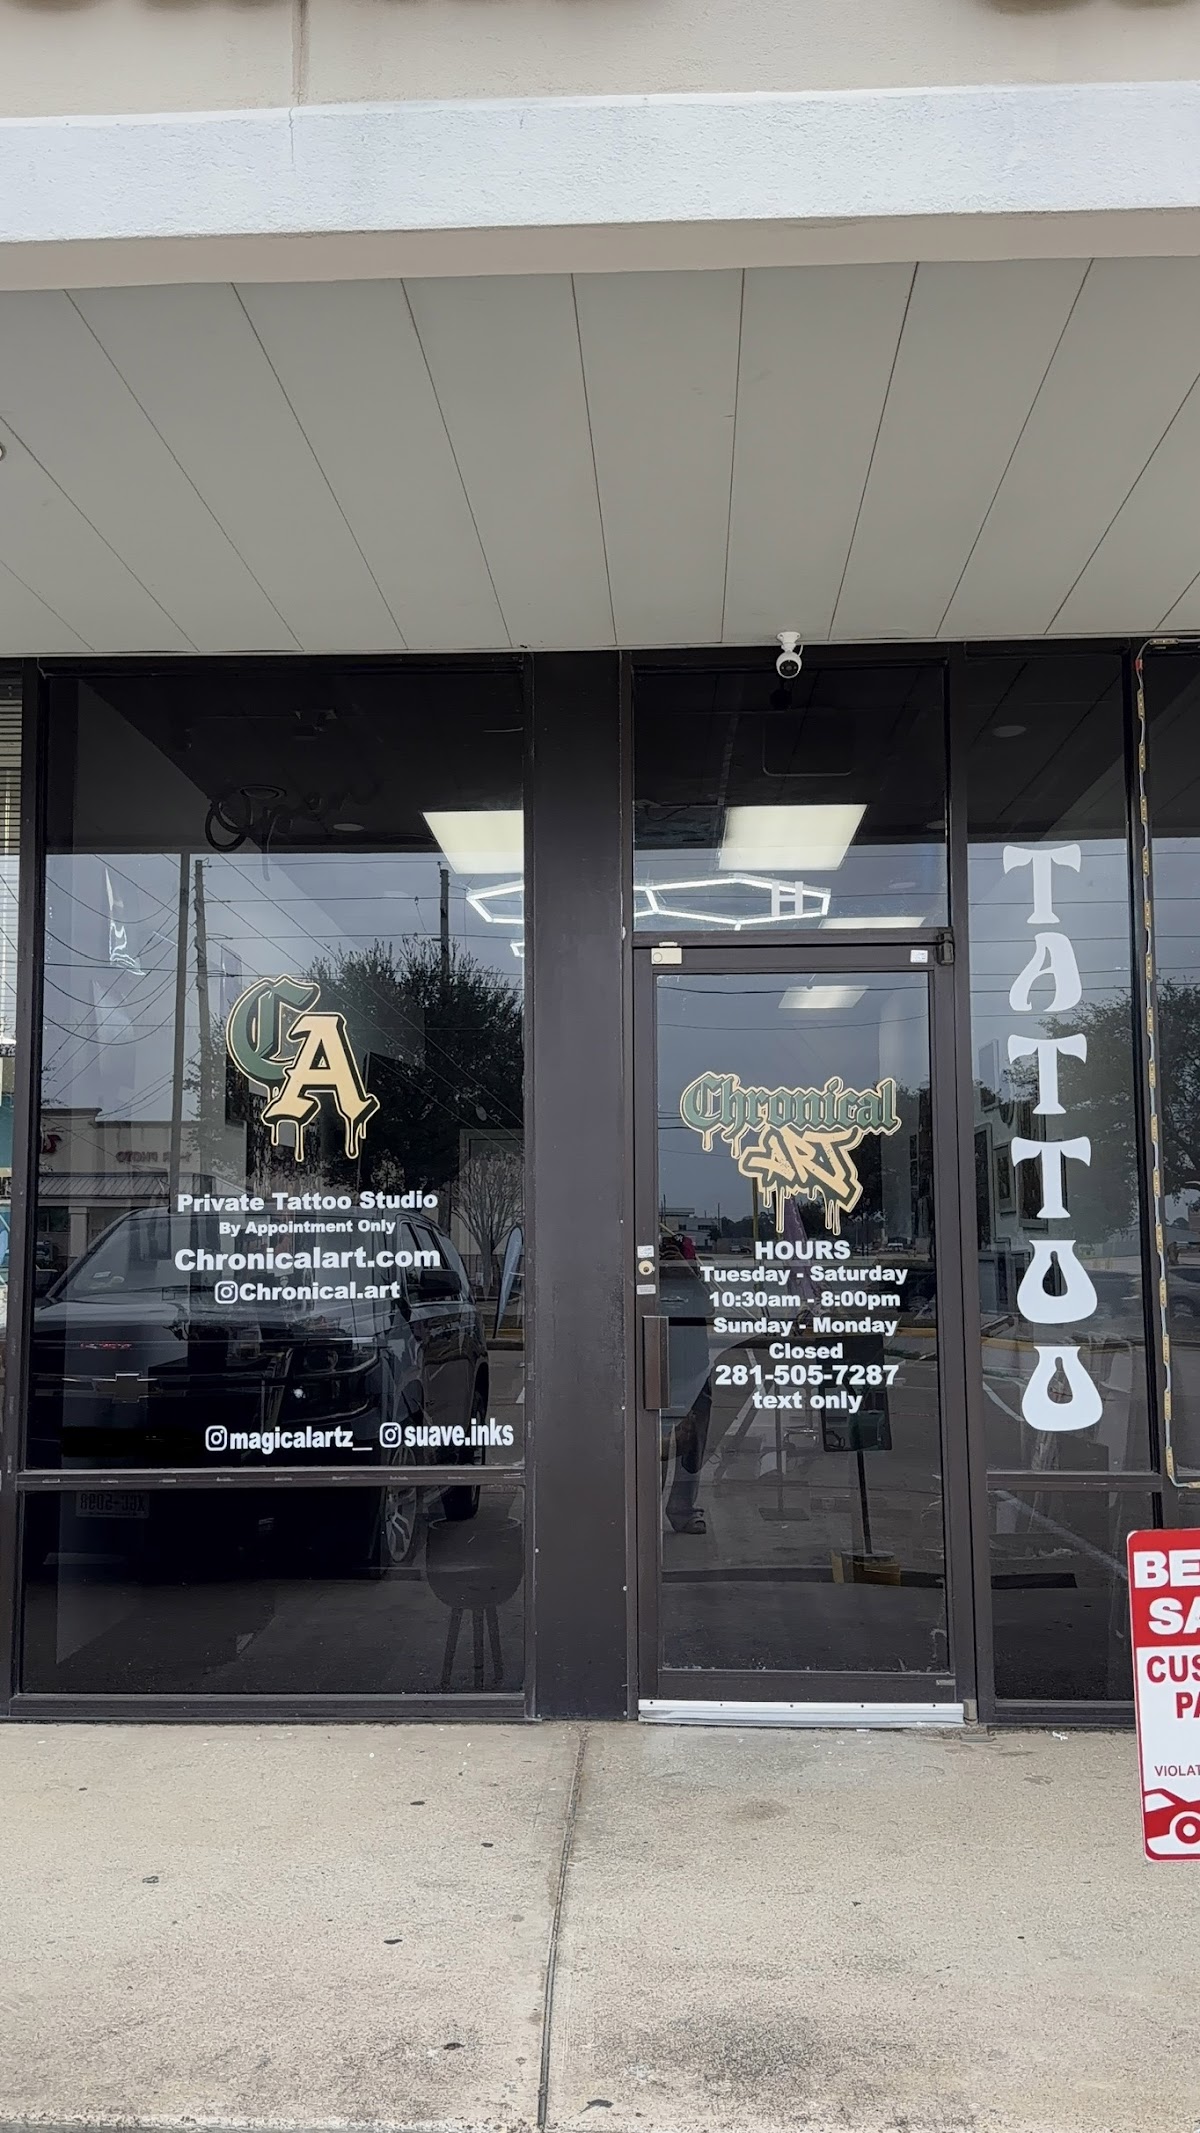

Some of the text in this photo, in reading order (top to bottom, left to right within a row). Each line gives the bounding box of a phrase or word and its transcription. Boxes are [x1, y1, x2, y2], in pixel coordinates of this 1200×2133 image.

[226, 974, 380, 1152] CA
[680, 1071, 901, 1140] Chronical
[1003, 844, 1103, 1432] TATTOO
[738, 1127, 863, 1216] ART
[177, 1190, 438, 1213] Private Tattoo Studio
[219, 1218, 396, 1237] By Appointment Only
[174, 1246, 441, 1271] Chronicalart.com
[755, 1240, 851, 1260] HOURS
[700, 1265, 791, 1286] Tuesday
[810, 1265, 908, 1285] Saturday
[239, 1281, 401, 1301] Chronical.art
[709, 1291, 801, 1308] 10:30am
[821, 1290, 901, 1311] 8:00pm
[713, 1316, 794, 1337] Sunday
[812, 1316, 898, 1337] Monday
[769, 1342, 843, 1359] Closed
[715, 1364, 900, 1386] 281-505-7287
[751, 1390, 863, 1414] text only
[404, 1417, 514, 1447] suave.inks
